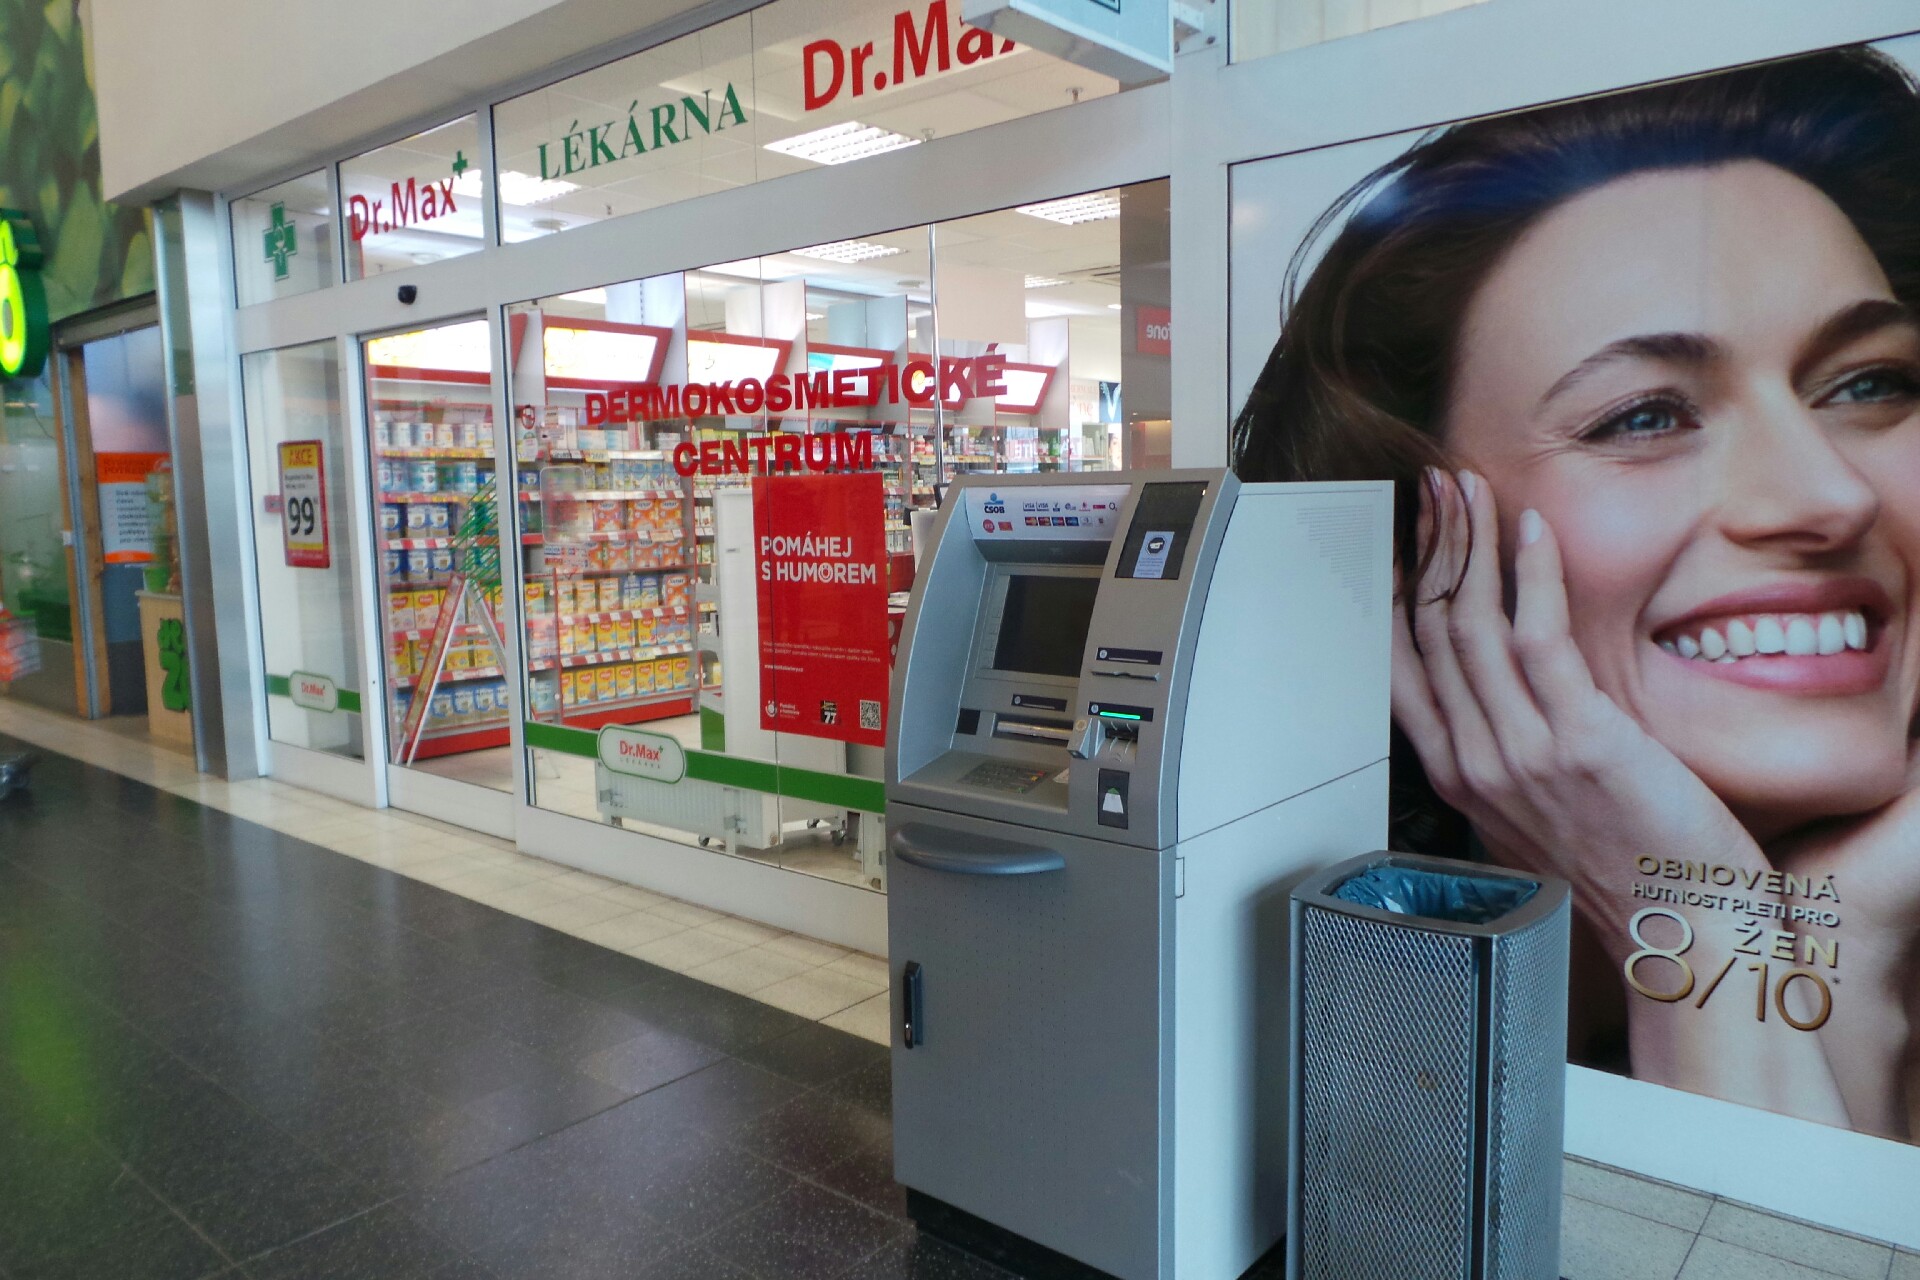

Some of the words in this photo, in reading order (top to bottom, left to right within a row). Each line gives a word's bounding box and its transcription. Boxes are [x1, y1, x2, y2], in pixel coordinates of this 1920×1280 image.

[804, 0, 1016, 112] Dr.Ma
[538, 83, 748, 183] LÉKÁRNA
[349, 175, 458, 242] Dr.Max
[585, 343, 1008, 426] DERMOKOSMETICKÉ
[673, 430, 874, 478] CENTRUM
[287, 497, 315, 536] 99
[761, 531, 852, 558] POMÁHEJ
[761, 561, 771, 581] S
[776, 562, 877, 584] HUMOREM
[619, 740, 660, 762] Dr.Max
[1634, 853, 1841, 904] OBNOVENÁ
[1631, 882, 1729, 912] HUTNOST
[1732, 899, 1786, 921] PLETI
[1791, 906, 1840, 928] PRO
[1733, 920, 1839, 968] ŽEN
